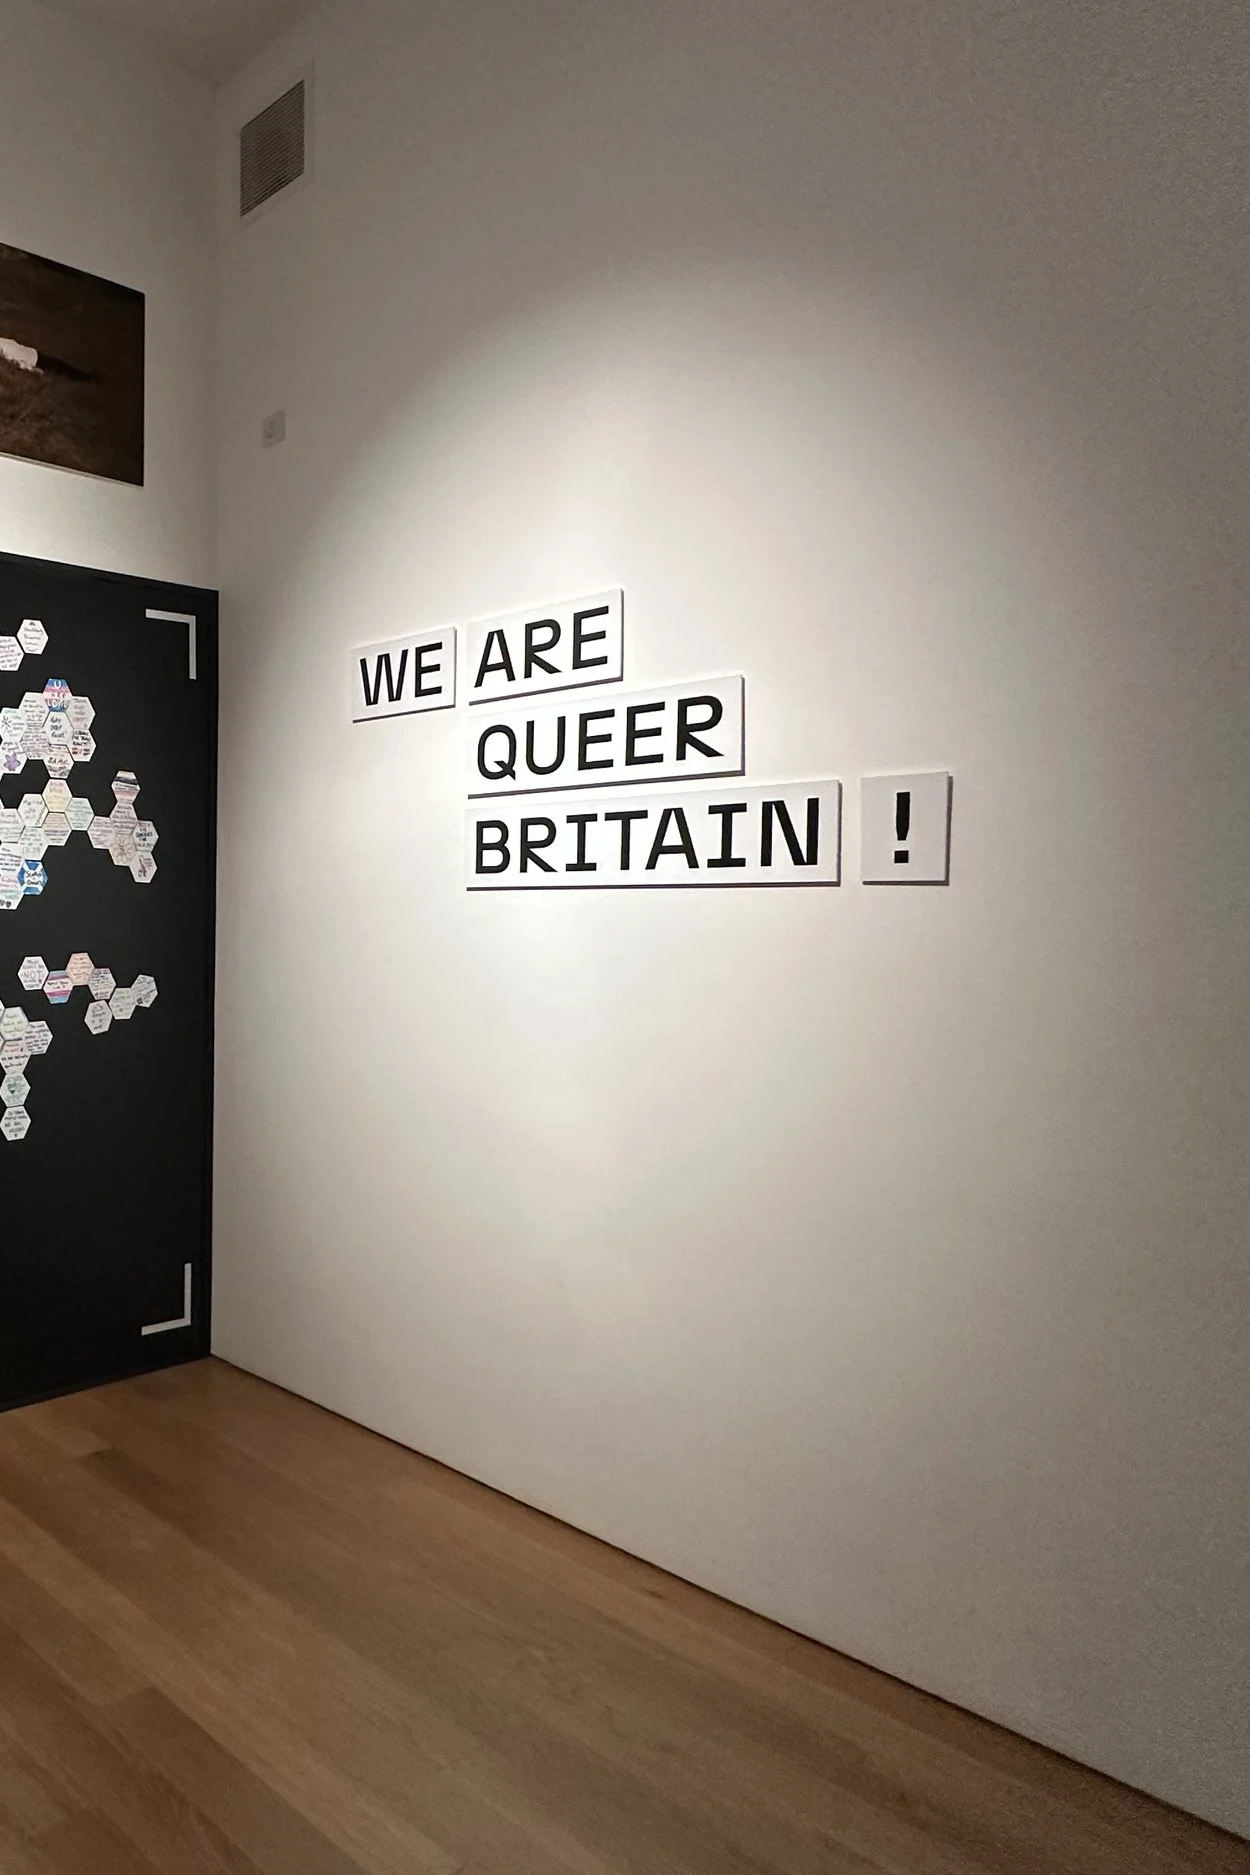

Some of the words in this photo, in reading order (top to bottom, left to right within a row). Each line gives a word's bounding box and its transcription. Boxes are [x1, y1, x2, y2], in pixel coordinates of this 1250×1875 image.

[359, 641, 443, 706] WE
[474, 605, 609, 688] ARE
[477, 695, 725, 781] QUEER
[475, 797, 820, 874] BRITAIN
[893, 792, 911, 864] !
